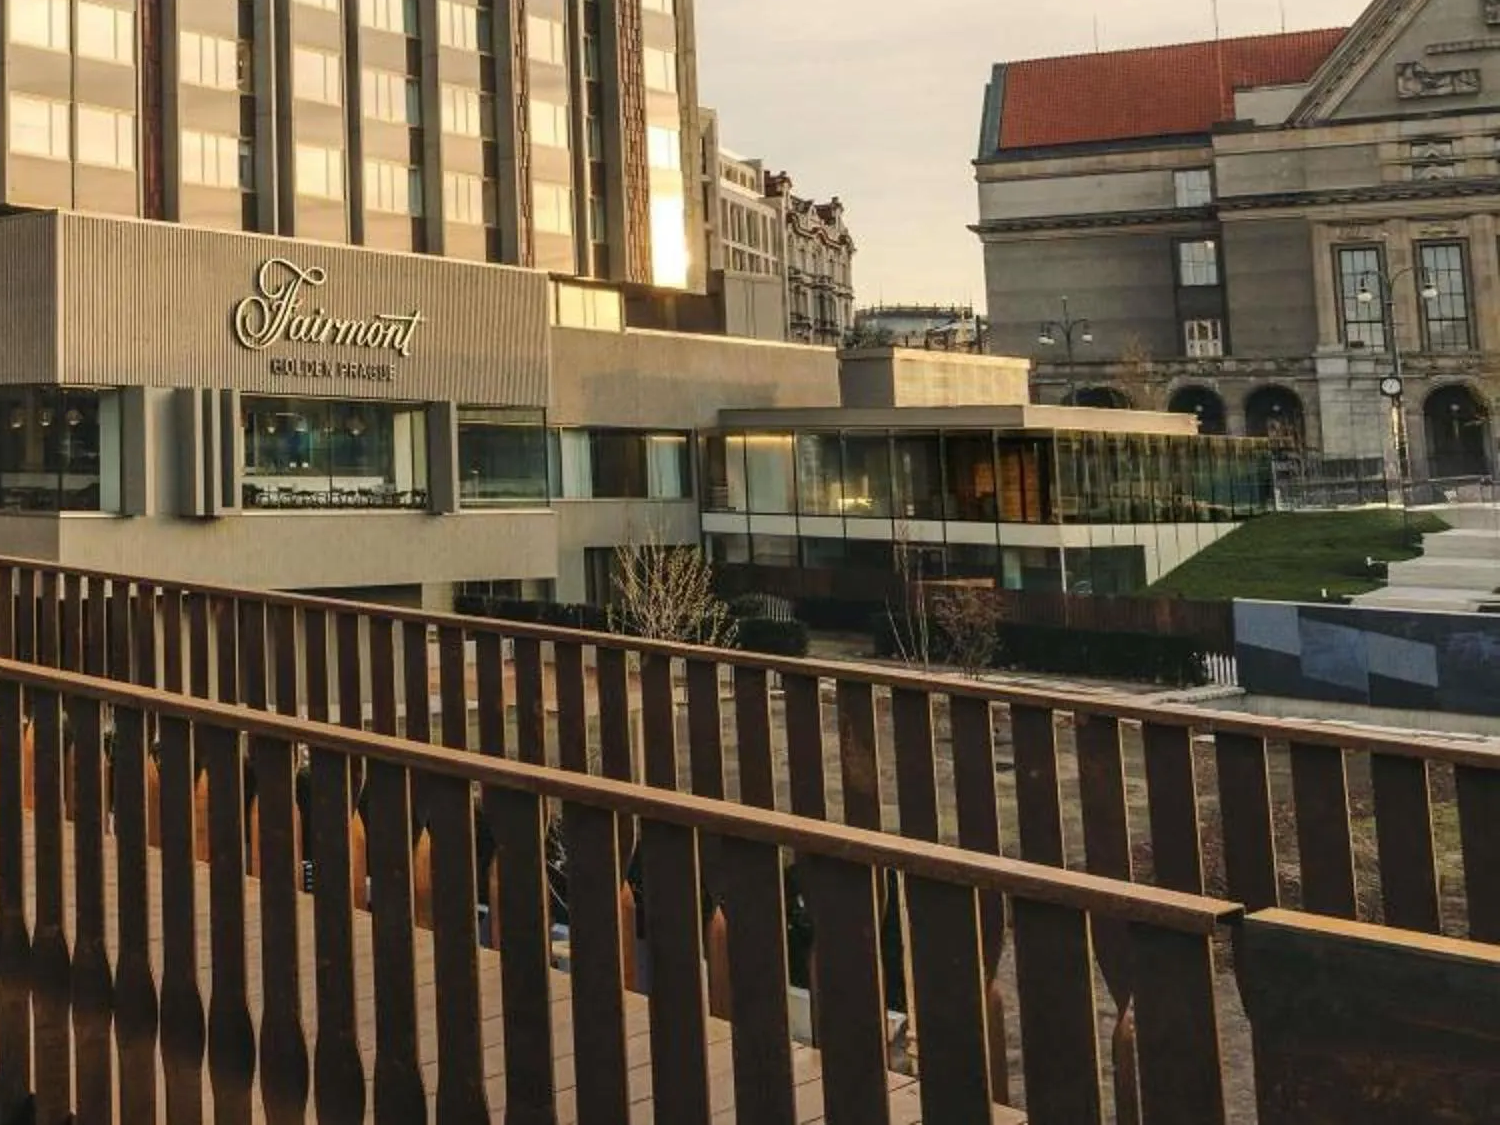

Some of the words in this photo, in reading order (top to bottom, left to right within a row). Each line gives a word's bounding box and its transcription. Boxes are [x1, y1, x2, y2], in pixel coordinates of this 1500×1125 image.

[235, 258, 426, 356] Fairmont
[270, 357, 334, 378] GOLDEN
[337, 360, 397, 381] PRAGUE
